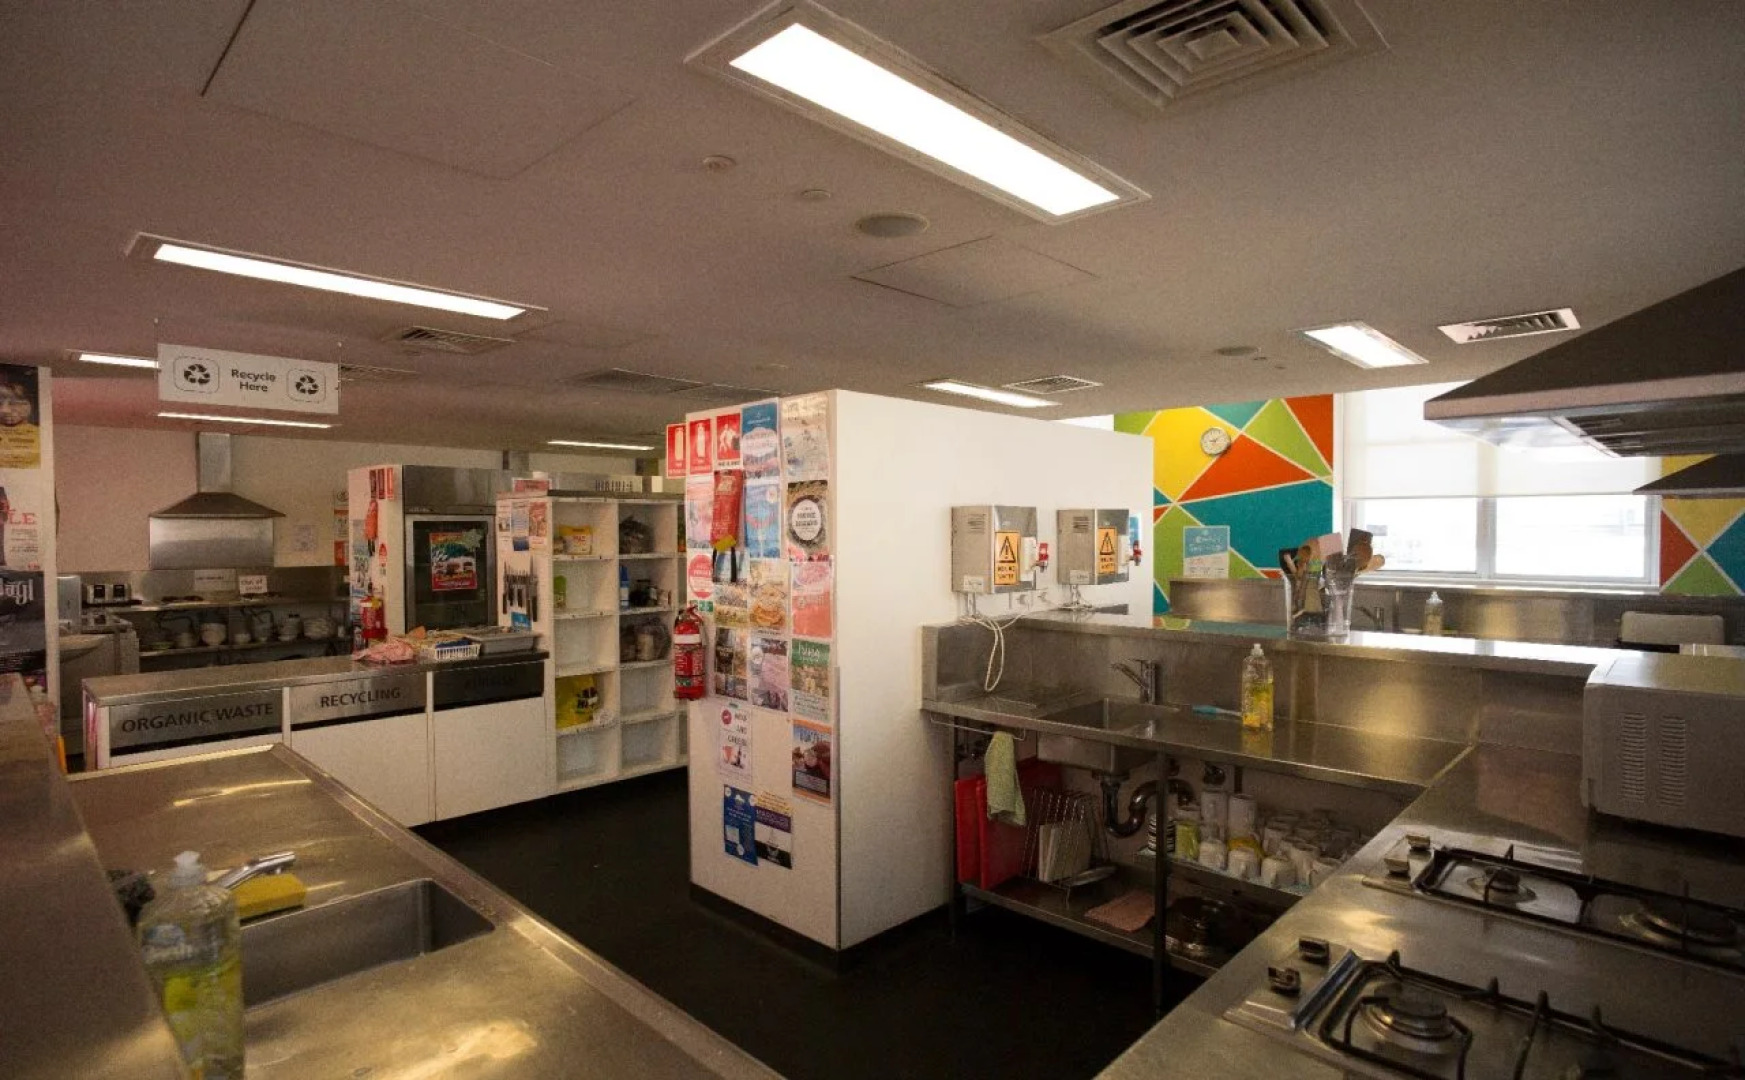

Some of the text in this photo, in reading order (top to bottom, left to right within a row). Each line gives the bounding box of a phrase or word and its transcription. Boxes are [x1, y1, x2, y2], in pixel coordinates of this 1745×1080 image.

[231, 369, 276, 382] Recycle
[239, 381, 268, 392] Here
[320, 686, 400, 708] RECYCLING
[121, 702, 273, 732] ORGANIC WASTE
